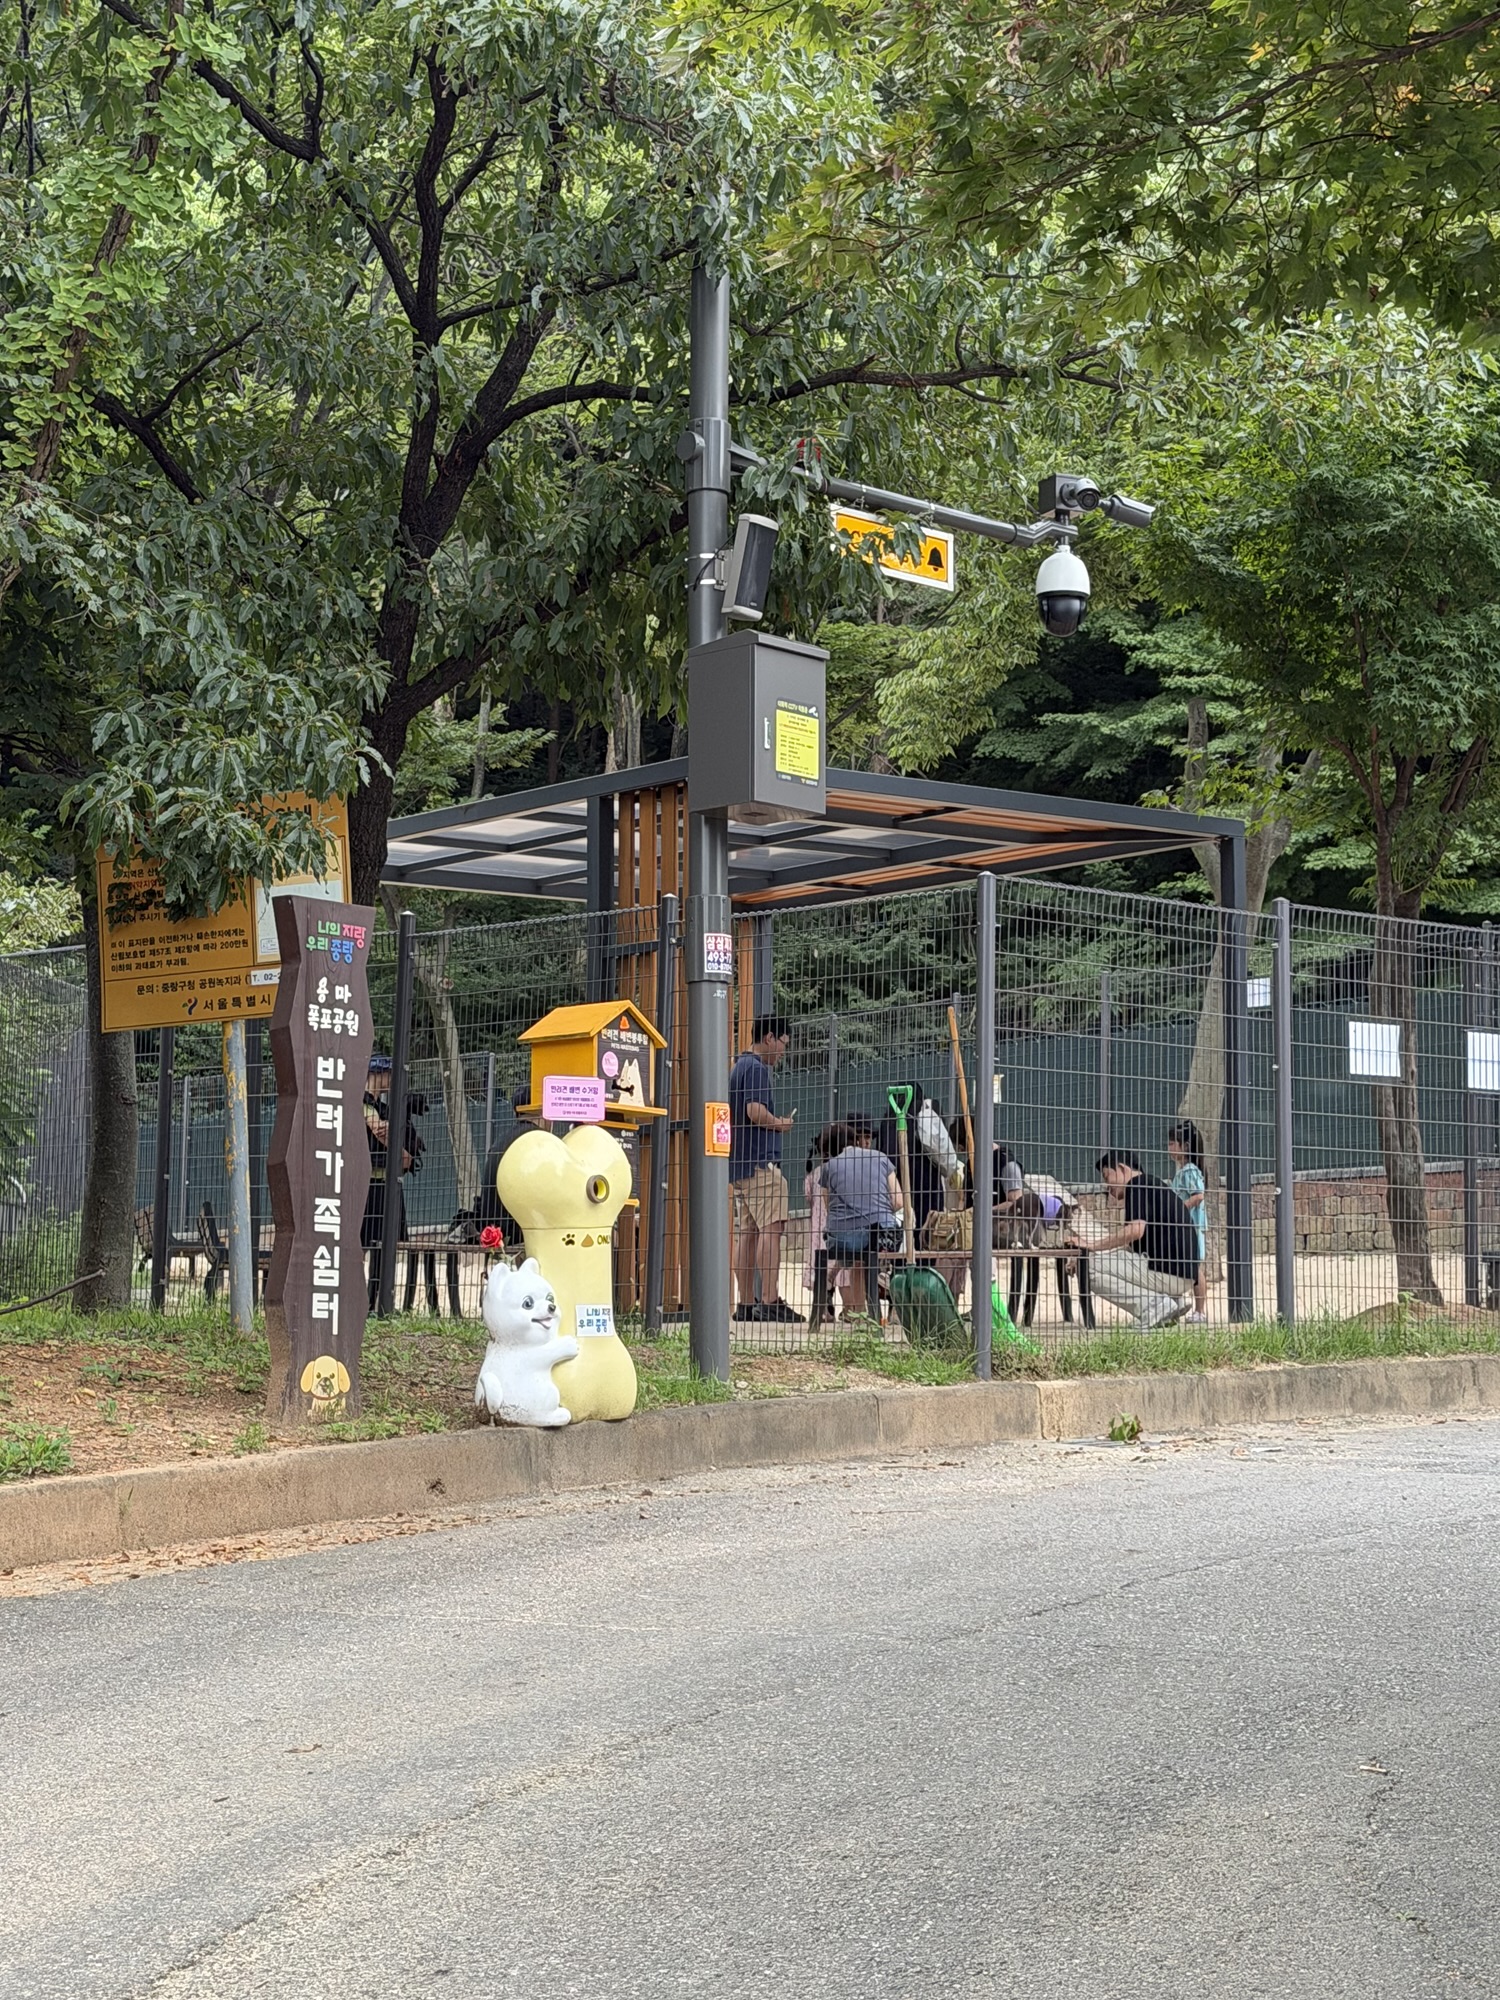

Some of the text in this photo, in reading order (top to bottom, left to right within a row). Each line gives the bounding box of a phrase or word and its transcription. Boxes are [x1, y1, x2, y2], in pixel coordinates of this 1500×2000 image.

[128, 937, 156, 948] 표지판을
[159, 933, 194, 944] 이전하거나
[318, 920, 366, 949] 나의 자랑
[110, 949, 146, 961] 산림보호법
[149, 946, 172, 957] 제57조
[220, 938, 249, 949] 200만원
[306, 936, 354, 963] 우리 중랑
[111, 961, 132, 972] 이하의
[161, 980, 195, 993] 중랑구청
[199, 976, 241, 990] 공원녹지과
[203, 994, 271, 1011] 서울특별시
[307, 1003, 359, 1036] 폭포공원
[551, 1085, 568, 1094] 반려견
[597, 1235, 611, 1245] ONL
[578, 1319, 608, 1333] 우리 중랑
